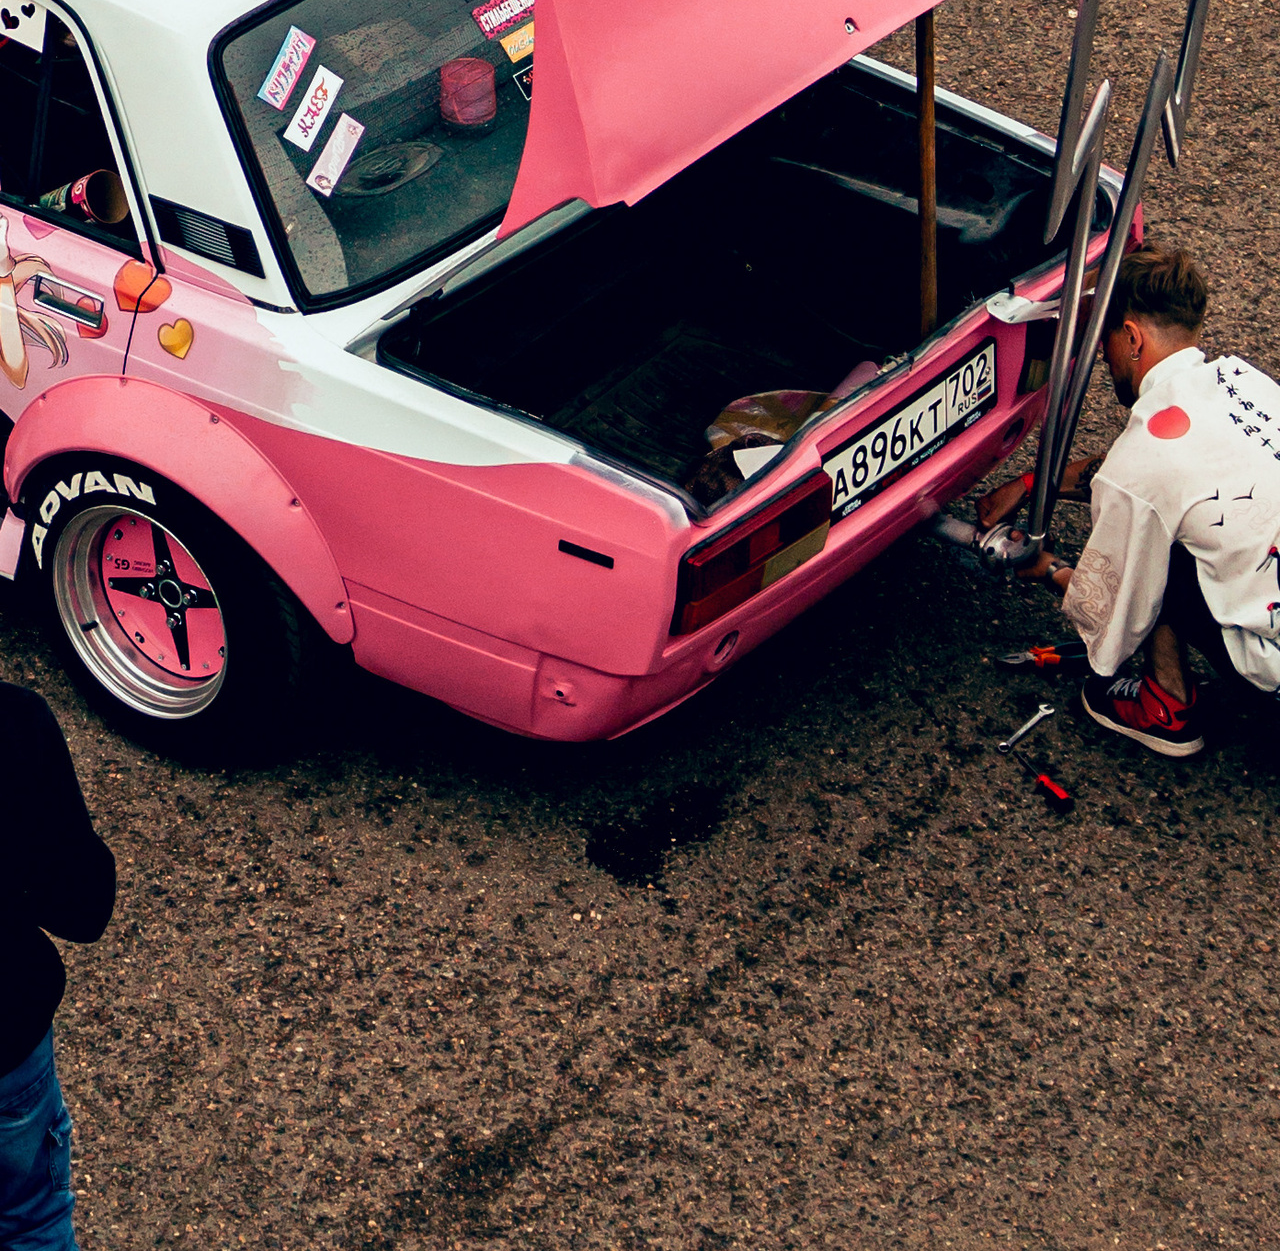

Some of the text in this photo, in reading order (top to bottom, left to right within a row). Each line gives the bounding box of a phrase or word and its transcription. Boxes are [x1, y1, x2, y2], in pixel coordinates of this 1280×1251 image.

[833, 353, 988, 506] А896КТ 702
[957, 392, 977, 416] RUS
[32, 471, 157, 570] ADVAN
[114, 558, 130, 571] G5
